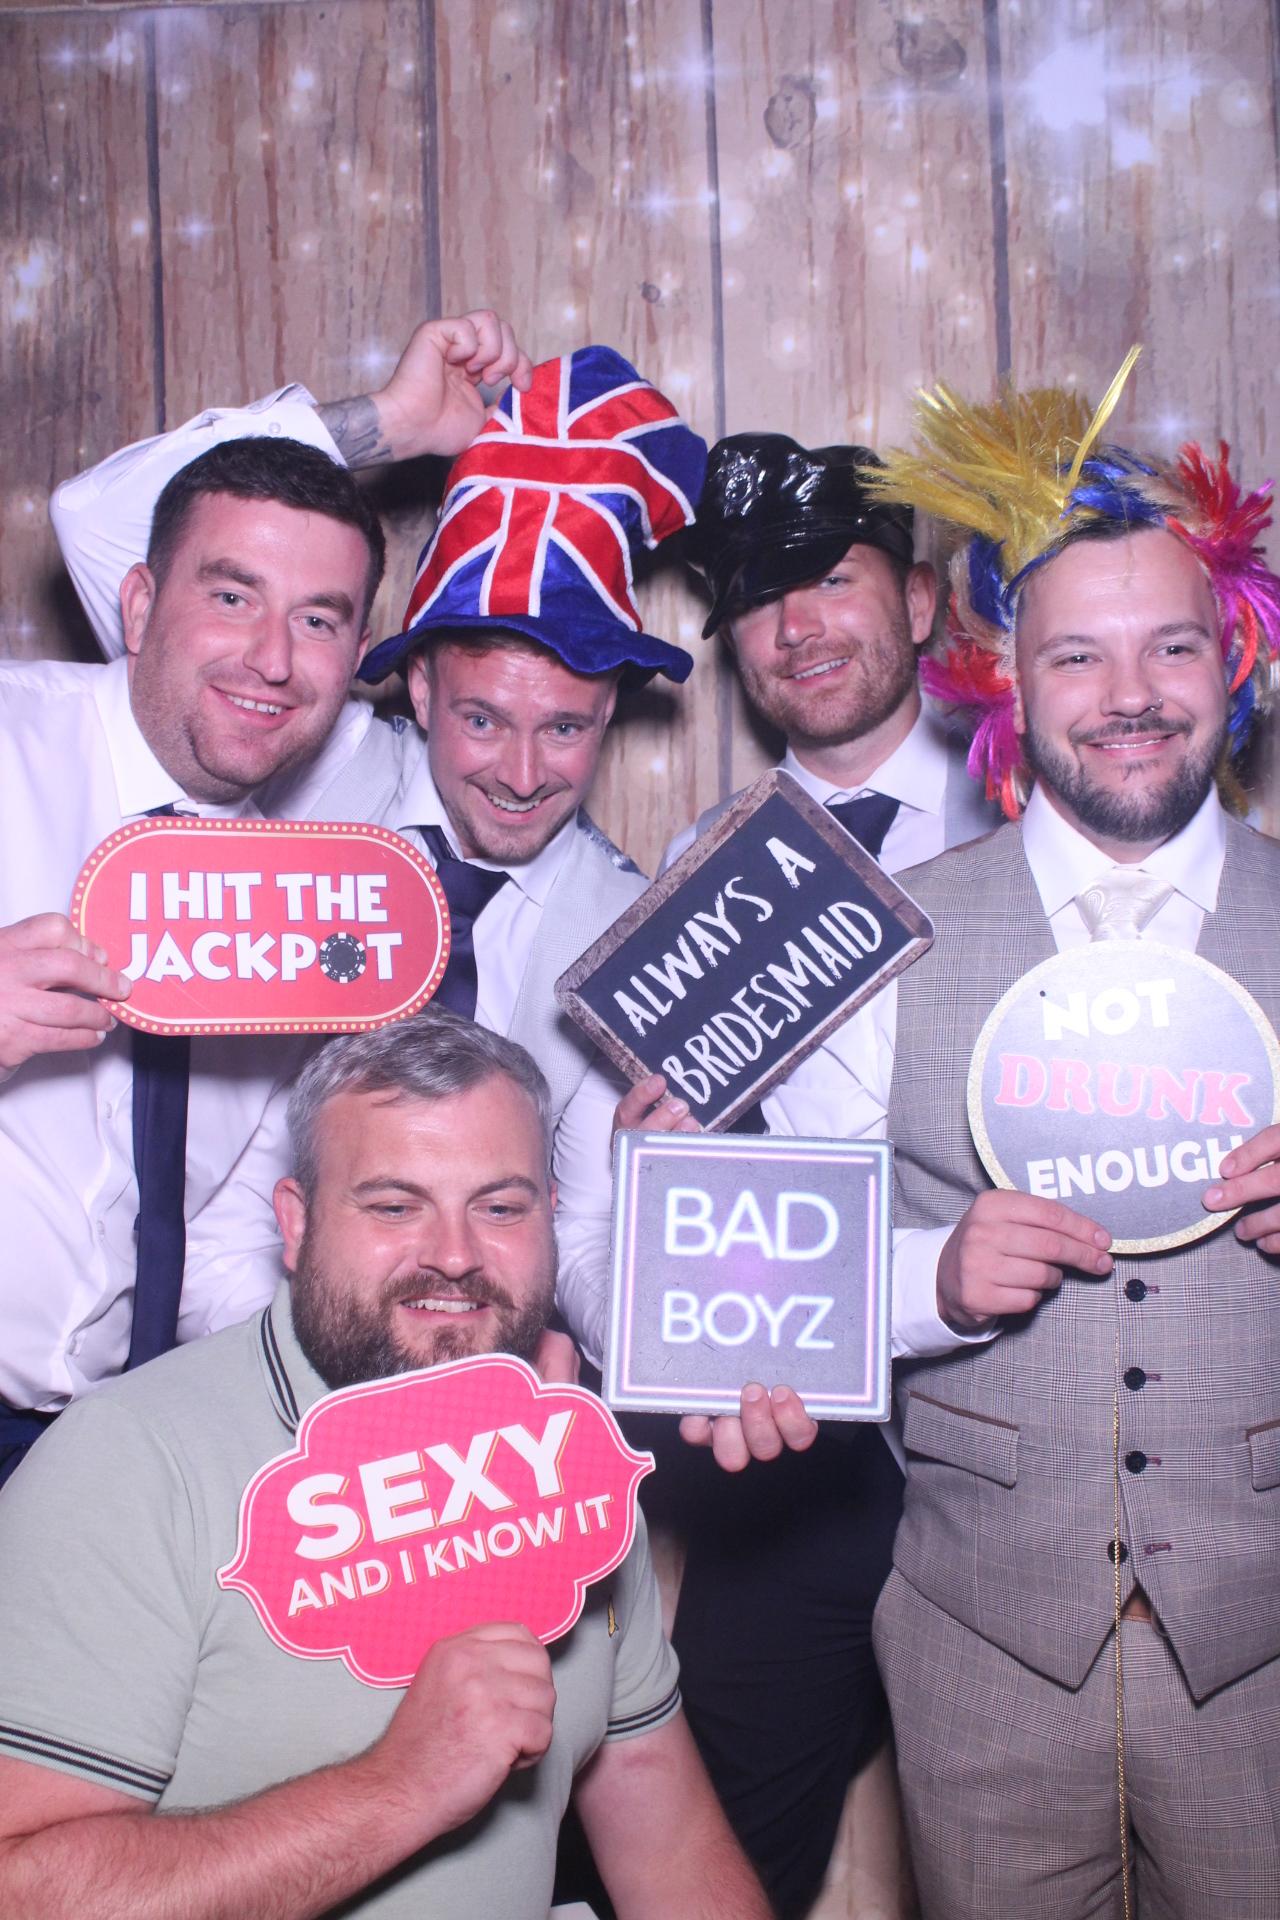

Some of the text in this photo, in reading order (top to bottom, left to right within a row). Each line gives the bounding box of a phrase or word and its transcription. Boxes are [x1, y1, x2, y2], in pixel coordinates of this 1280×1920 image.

[129, 871, 389, 923] I HIT THE
[119, 930, 403, 984] JACKPOT
[612, 836, 817, 1039] ALWAYS A
[661, 901, 883, 1105] BRIDESMAID
[1041, 978, 1176, 1041] NOT
[994, 1053, 1254, 1127] DRUNK
[664, 1187, 840, 1261] BAD
[661, 1290, 835, 1349] BOYZ
[286, 1409, 577, 1560] SEXY
[287, 1493, 614, 1617] AND I KNOW IT
